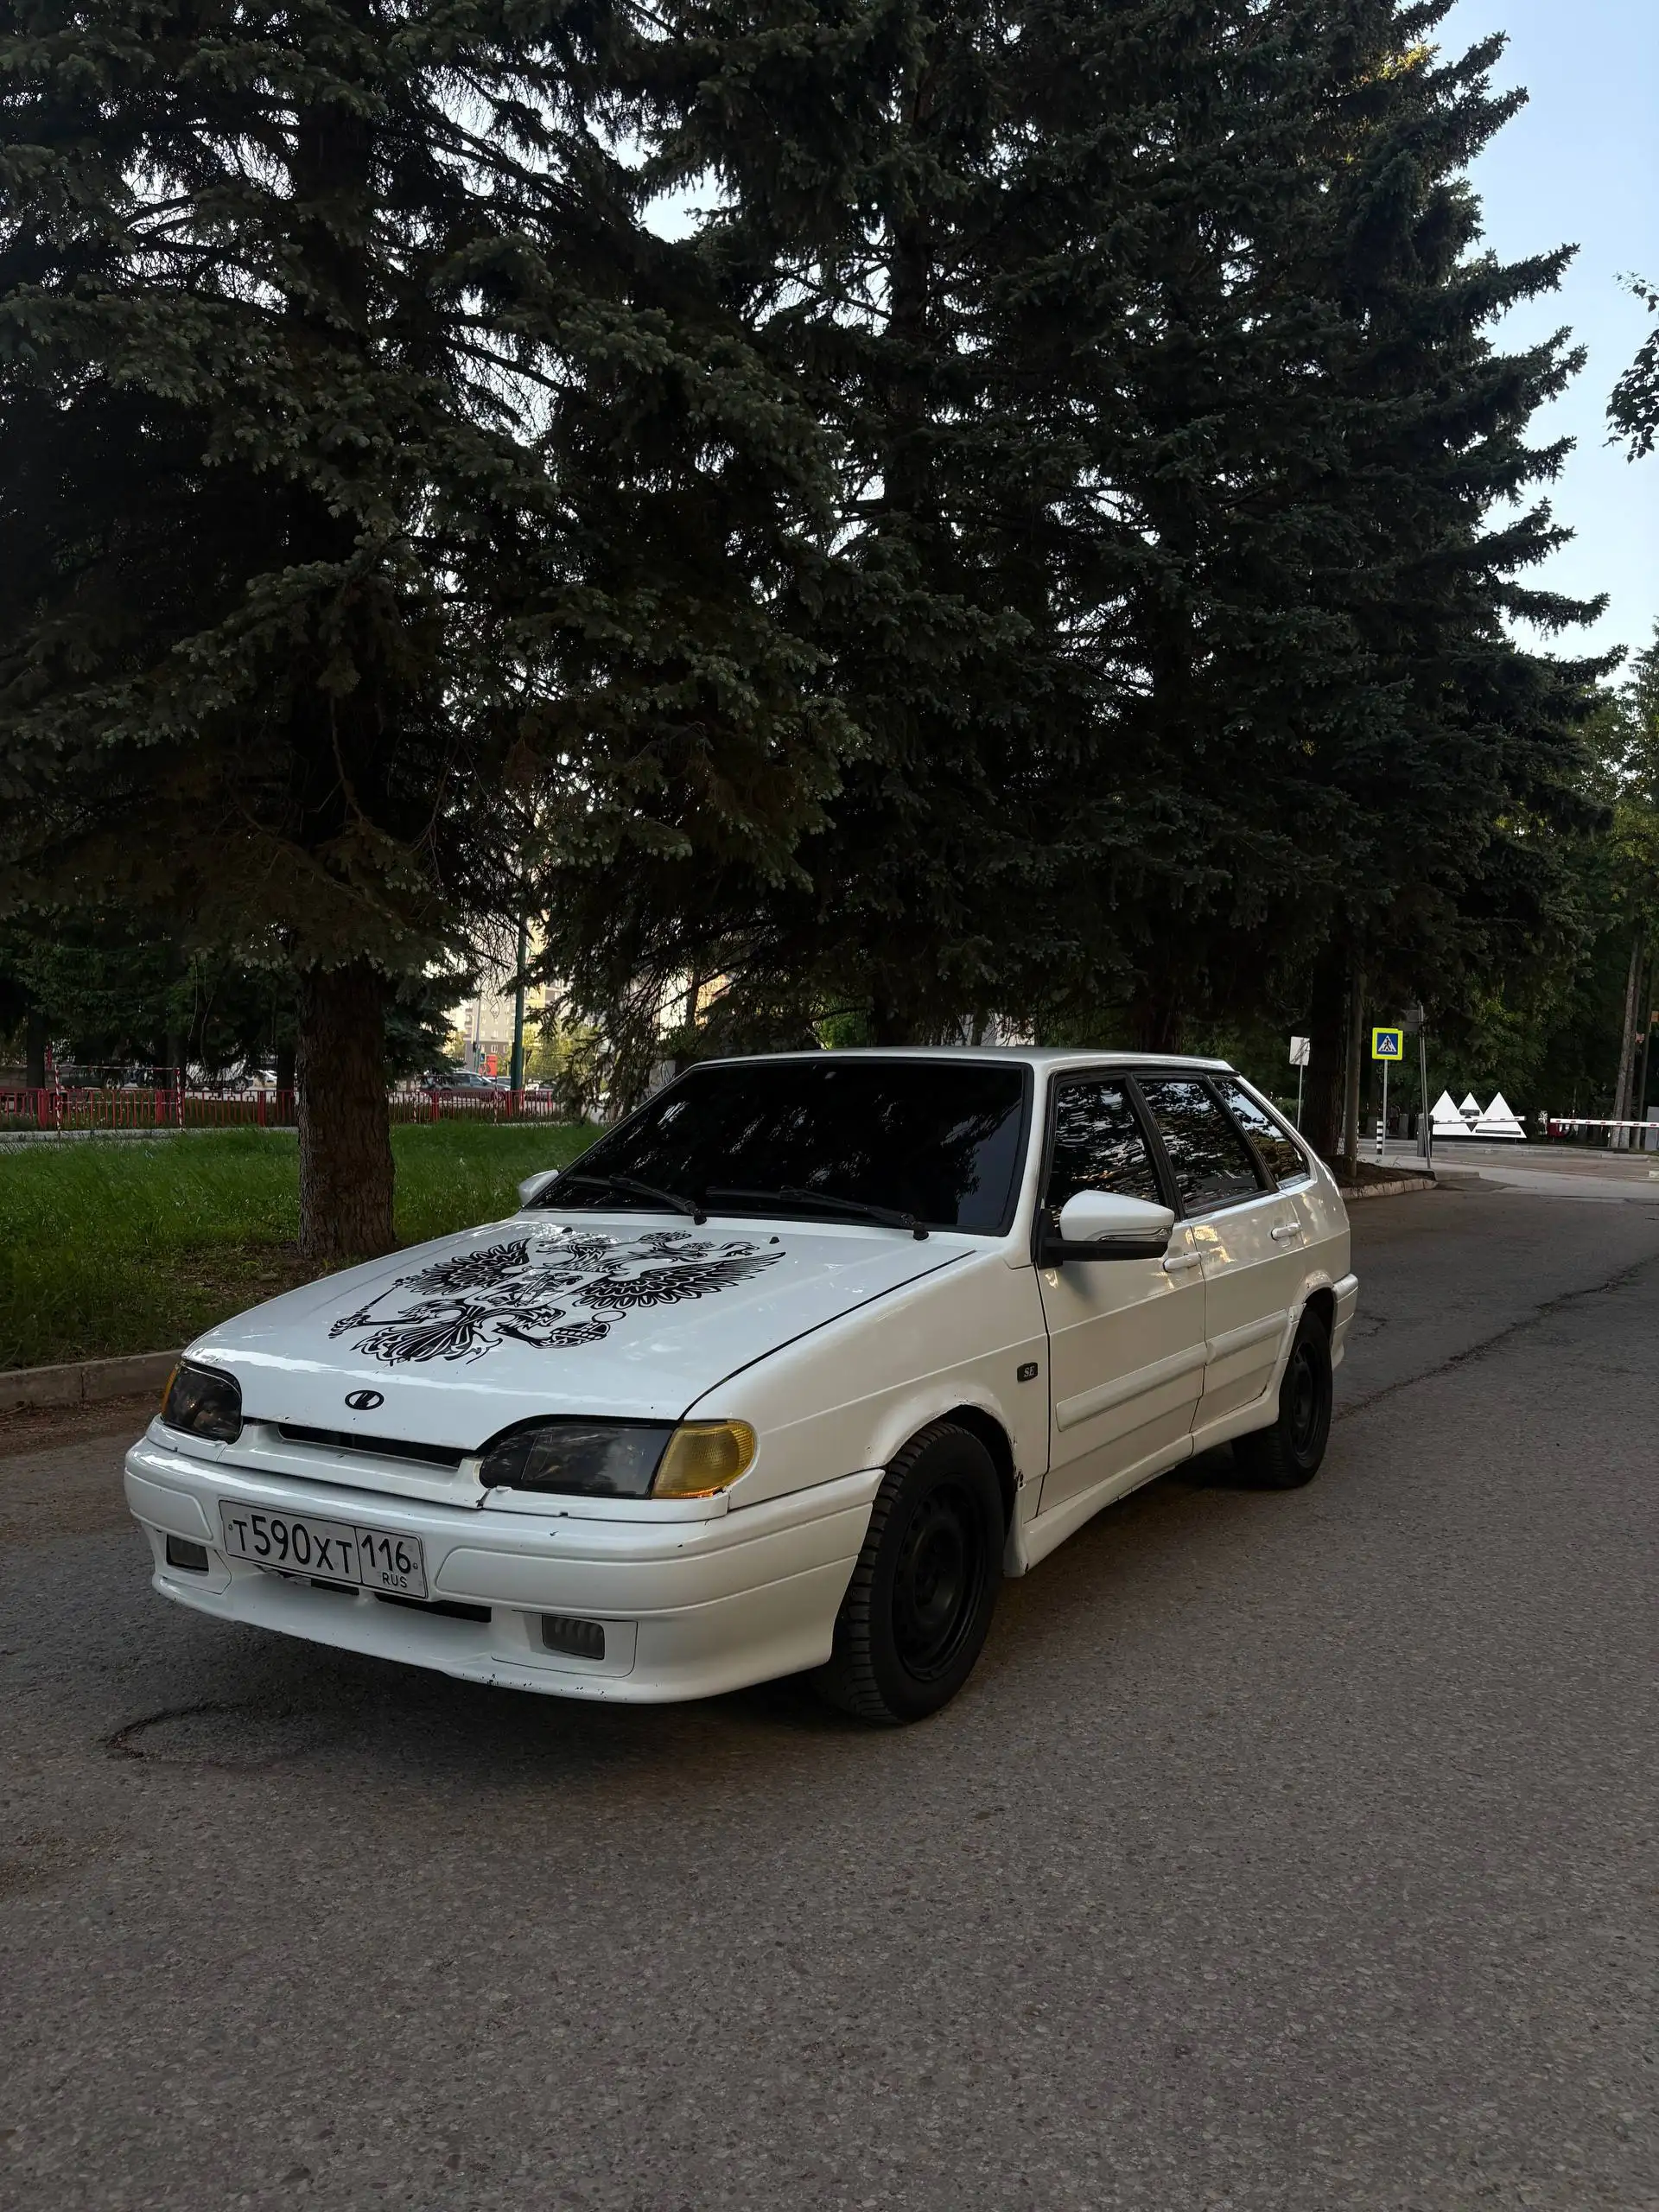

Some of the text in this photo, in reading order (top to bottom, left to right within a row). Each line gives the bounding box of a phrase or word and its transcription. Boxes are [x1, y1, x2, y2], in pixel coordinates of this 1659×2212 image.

[232, 1515, 411, 1573] Т590ХТ 116
[382, 1572, 408, 1588] RUS
